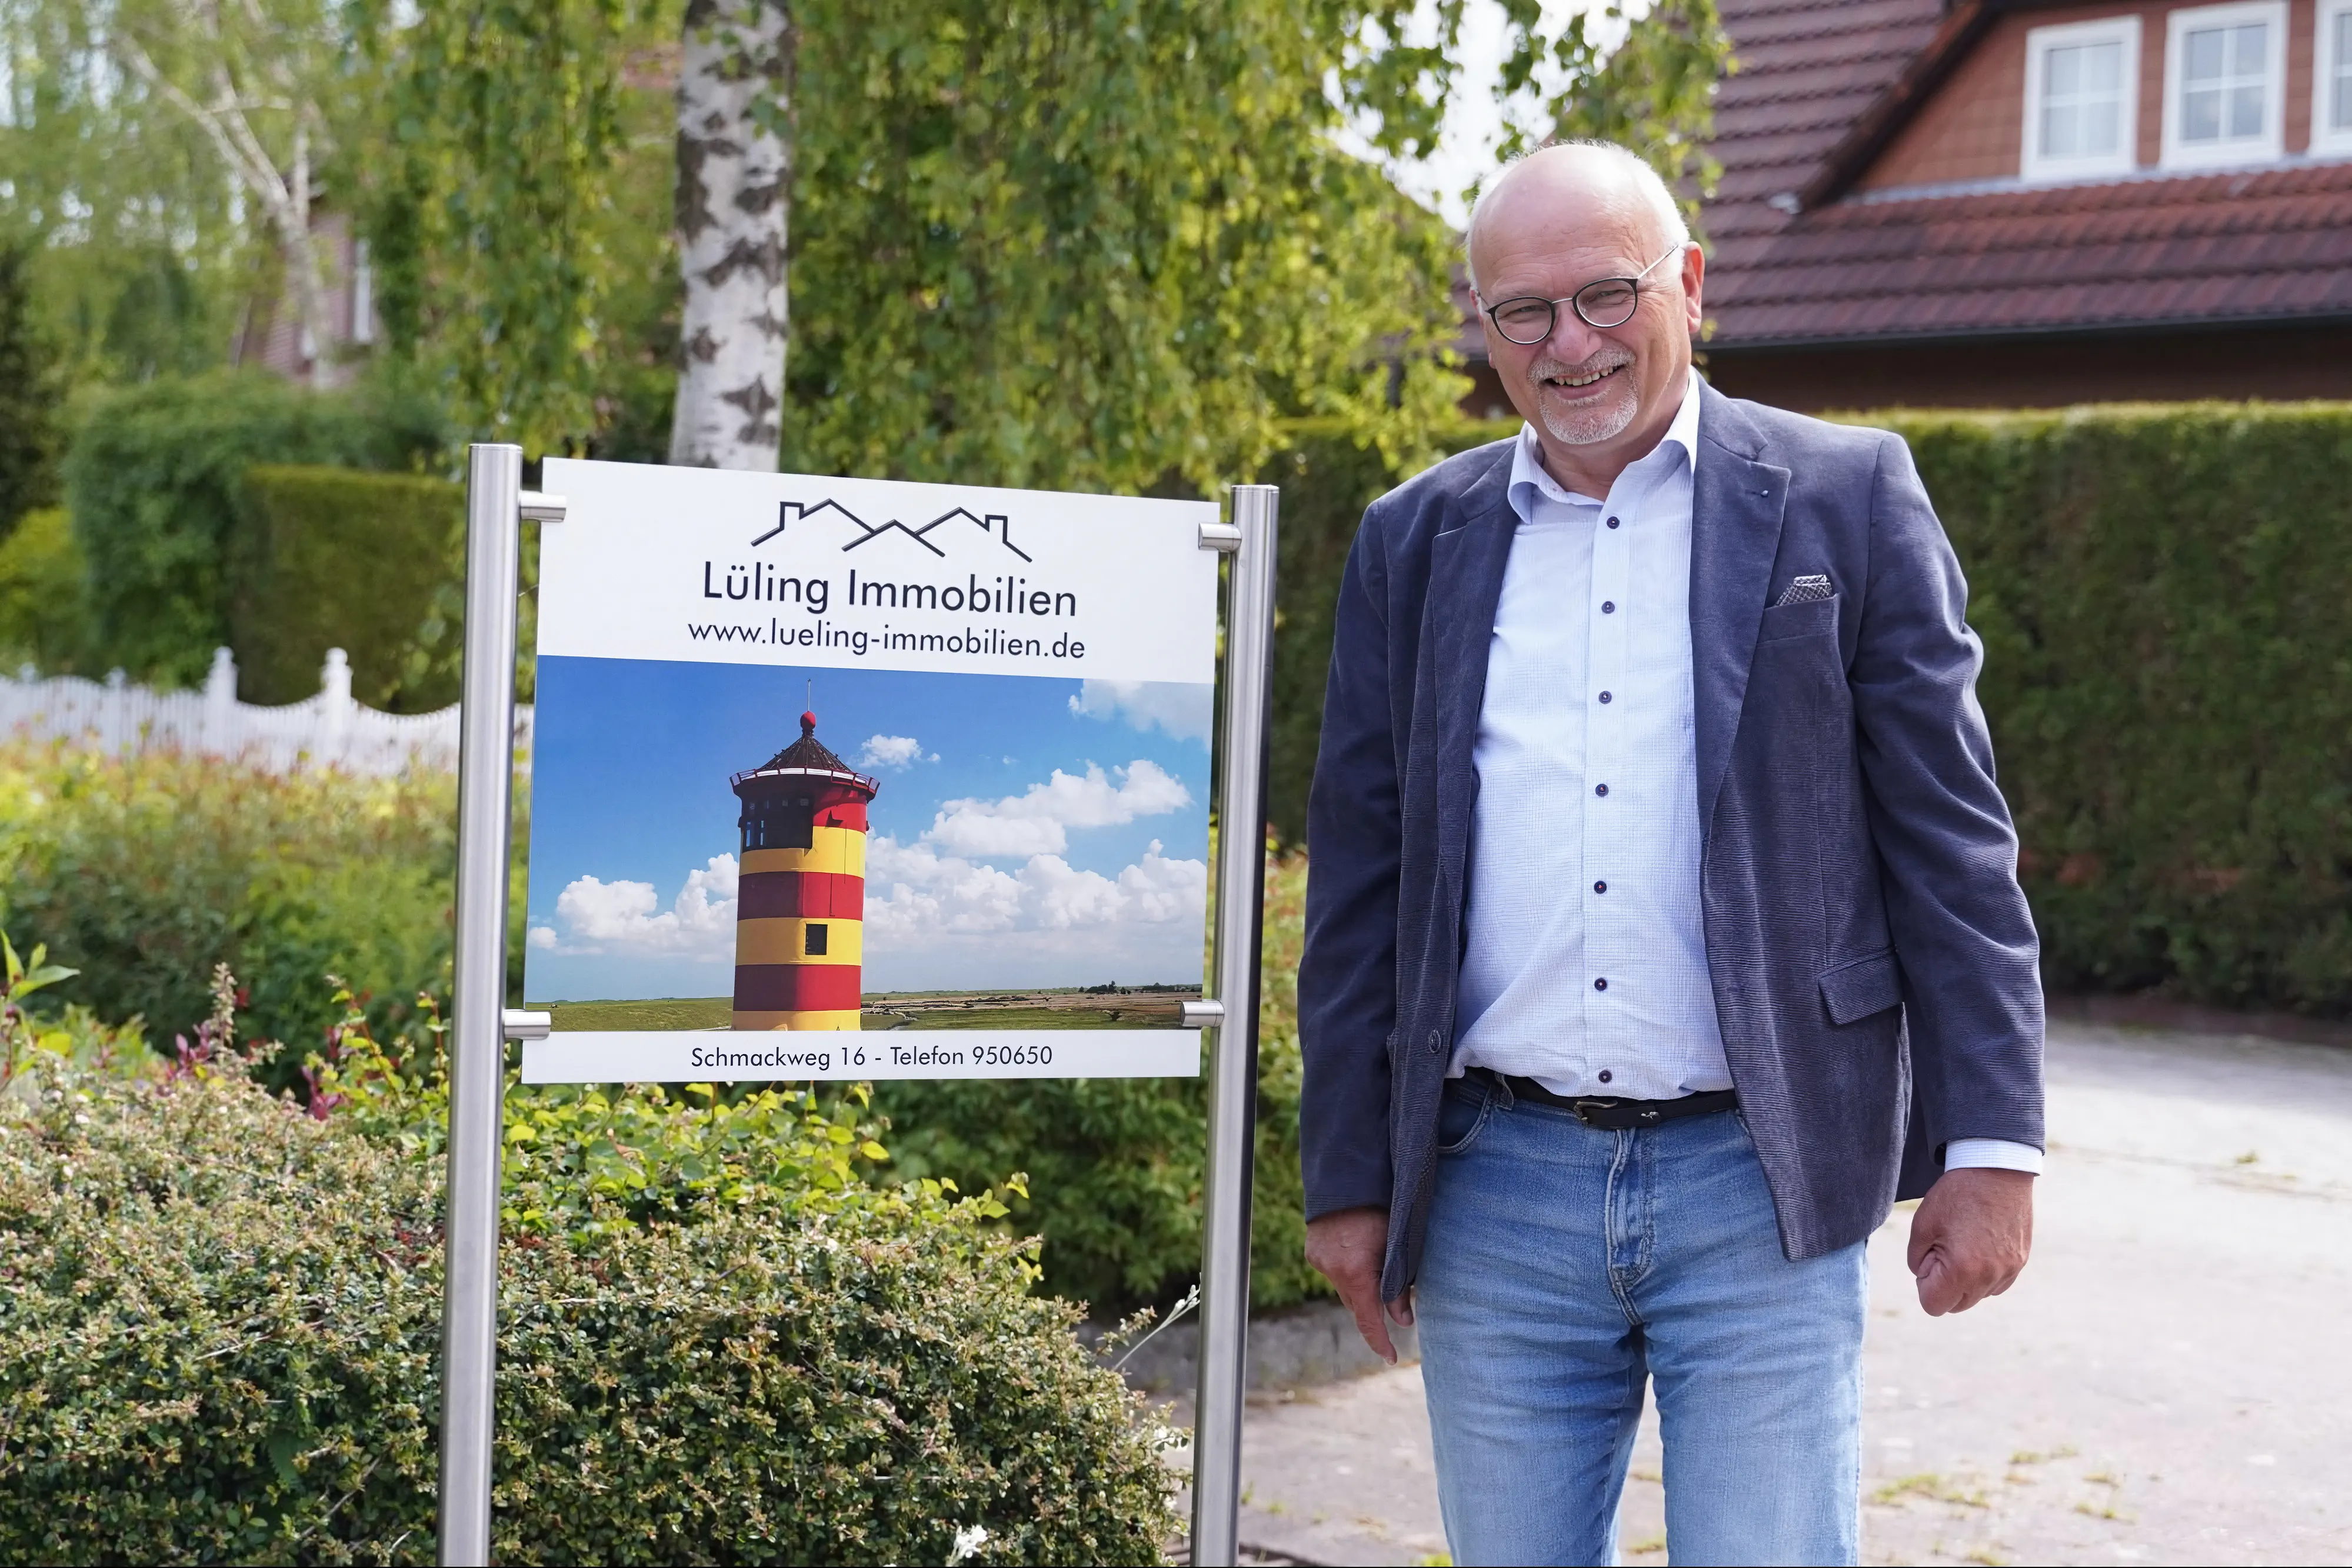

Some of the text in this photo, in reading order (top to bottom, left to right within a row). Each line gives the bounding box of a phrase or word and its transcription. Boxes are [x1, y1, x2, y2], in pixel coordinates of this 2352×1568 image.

[703, 561, 1077, 616] Lüling Immobilien
[687, 617, 1085, 659] www.lueling-immobilien.de
[691, 1046, 831, 1072] Schmackweg
[841, 1046, 866, 1066] 16
[889, 1045, 964, 1066] Telefon
[972, 1045, 1053, 1066] 950650
